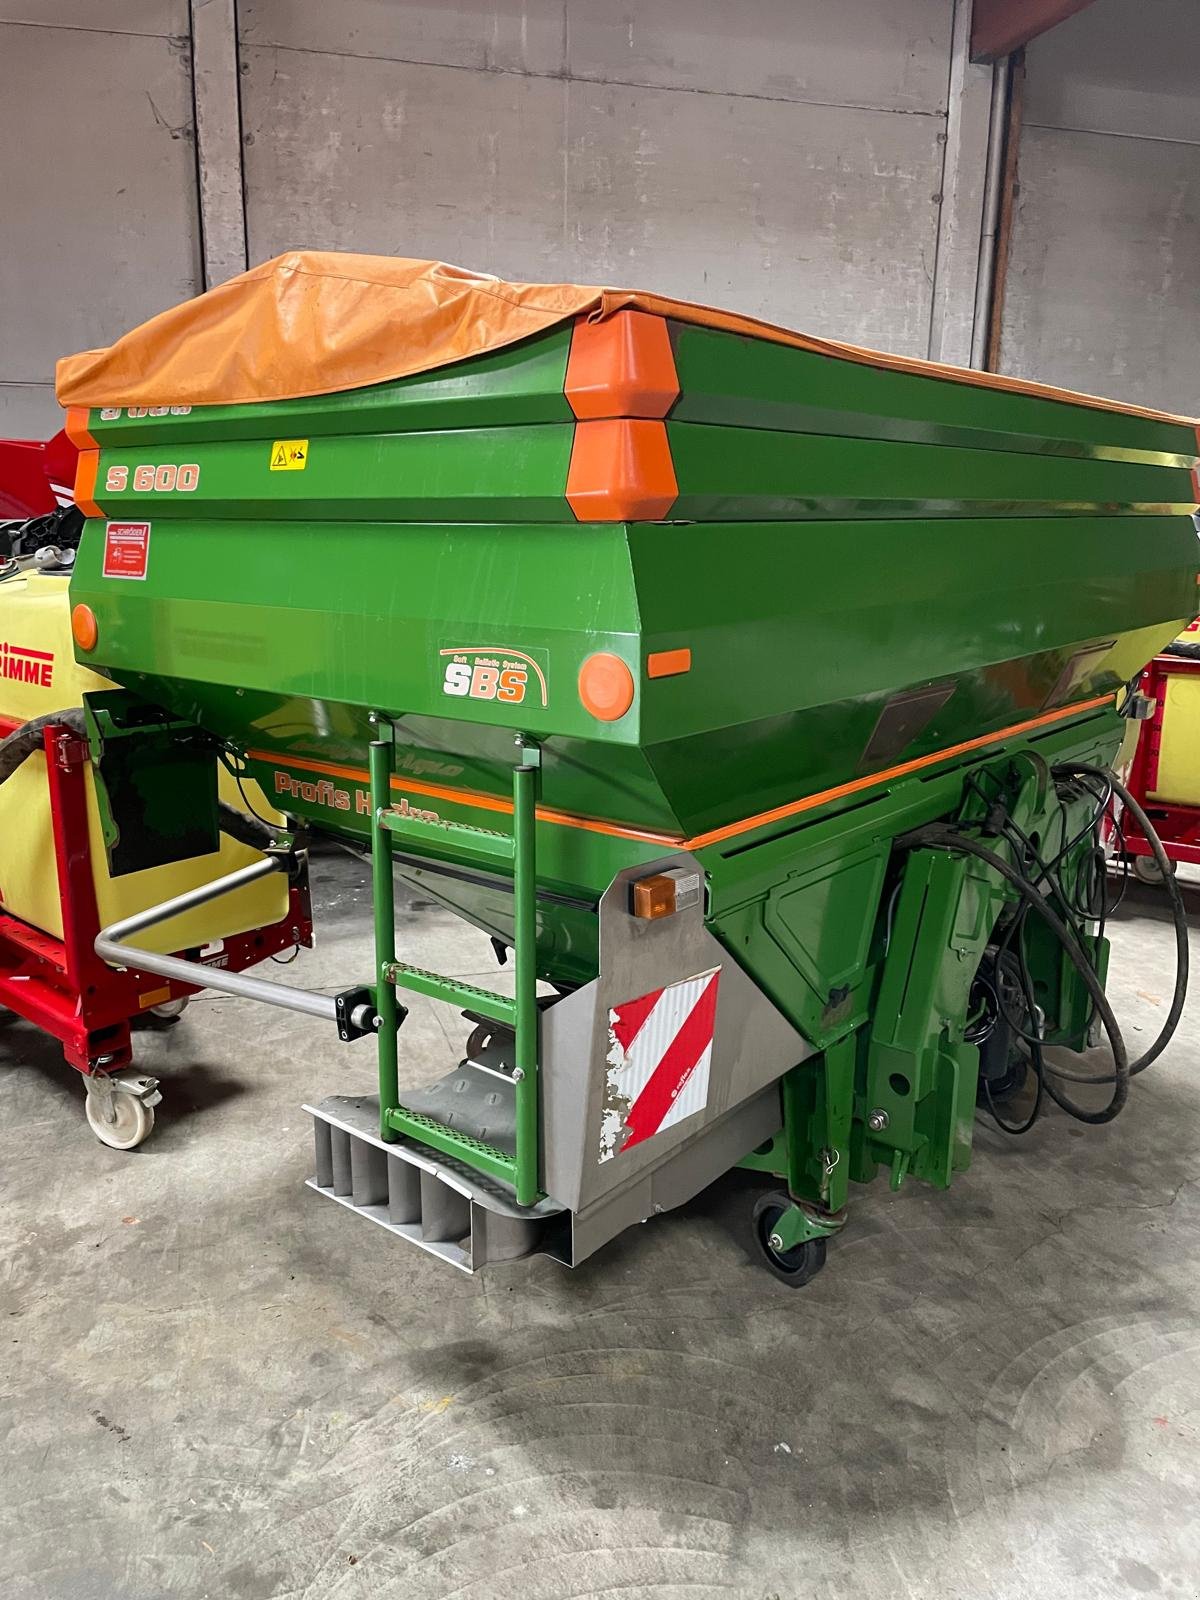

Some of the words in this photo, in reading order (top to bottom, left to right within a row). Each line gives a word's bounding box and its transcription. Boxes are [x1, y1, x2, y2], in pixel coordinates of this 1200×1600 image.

[106, 465, 129, 492] S
[133, 463, 200, 492] 600
[0, 643, 53, 688] IMME
[453, 654, 467, 664] Soft
[474, 657, 500, 668] Ballistic
[502, 660, 527, 671] System
[443, 662, 528, 704] SBS
[274, 771, 351, 811] Profis
